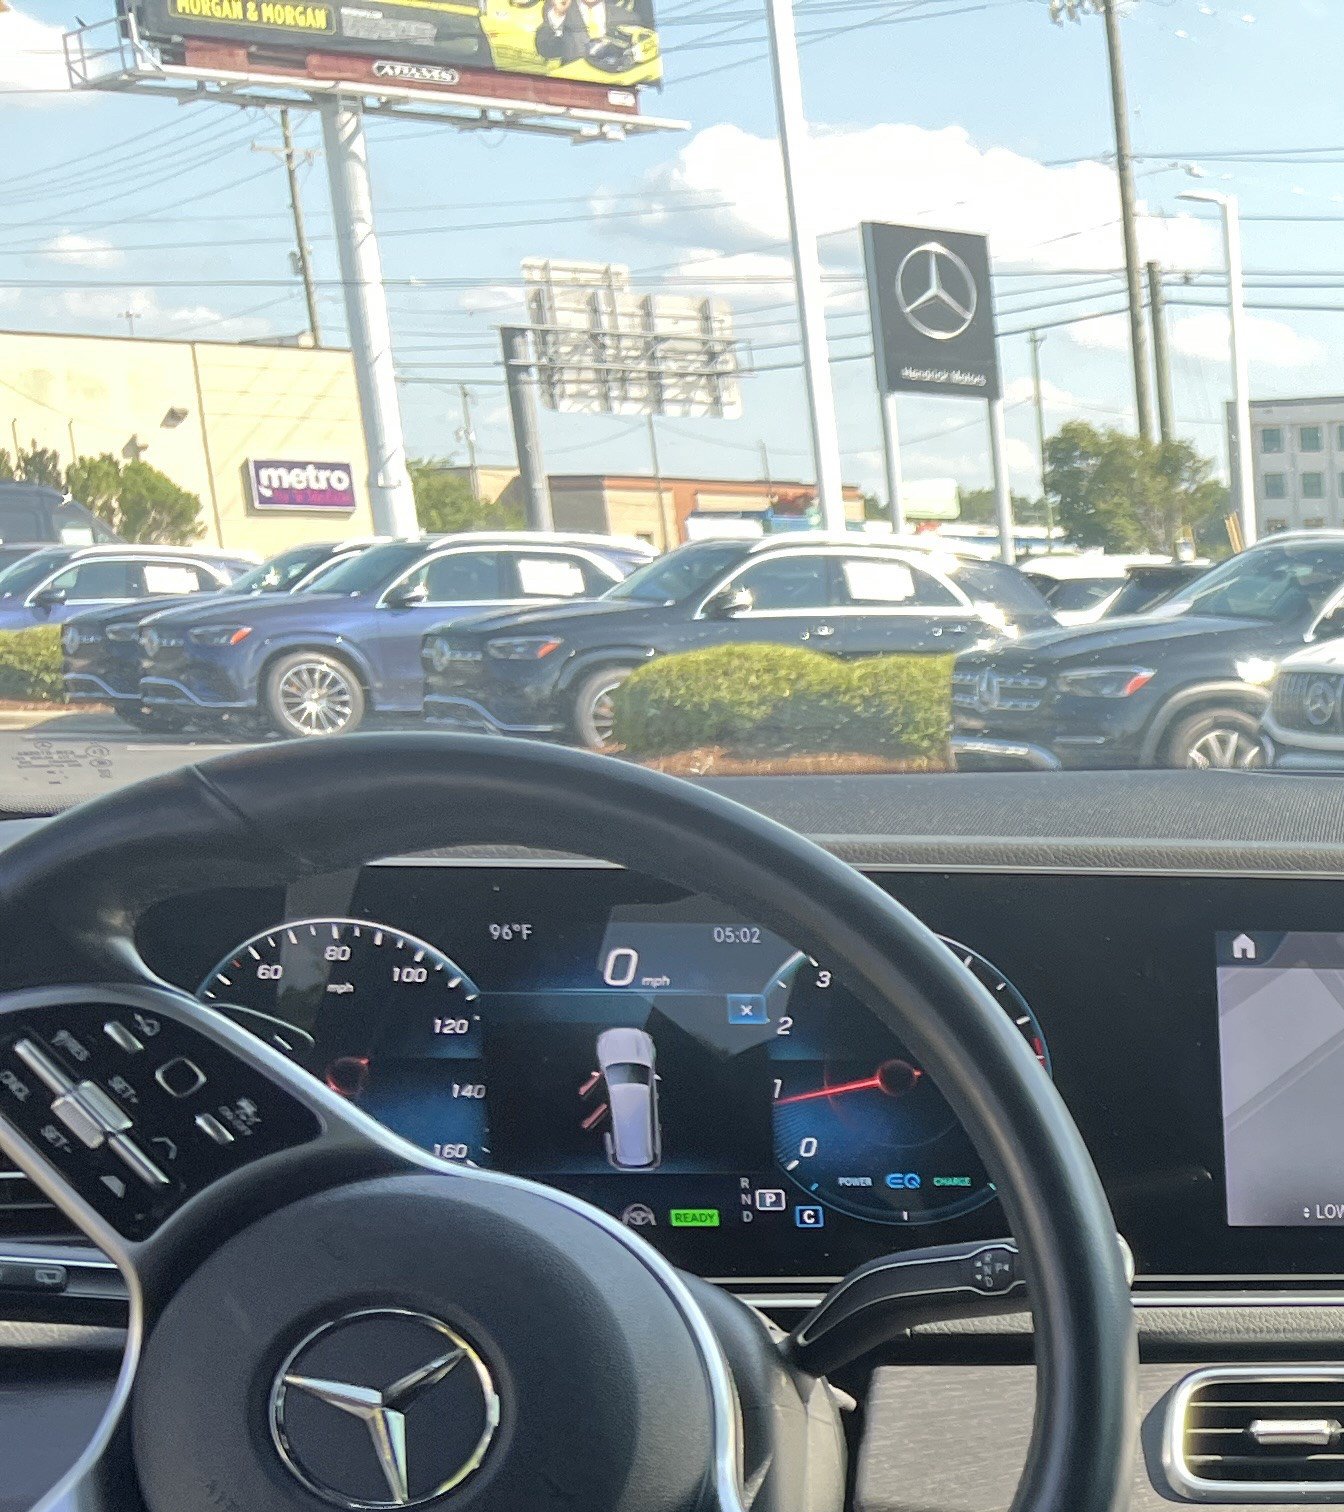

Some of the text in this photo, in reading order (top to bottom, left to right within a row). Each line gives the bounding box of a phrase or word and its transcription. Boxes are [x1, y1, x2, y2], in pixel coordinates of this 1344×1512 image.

[177, 0, 244, 20] MORGAN
[261, 6, 328, 29] MORGAN
[258, 463, 351, 497] metro
[488, 923, 533, 941] 96°F
[713, 926, 762, 944] 05:02
[324, 945, 351, 962] 80
[256, 964, 283, 980] 60
[392, 966, 428, 983] 100
[603, 947, 671, 989] 0 mph
[815, 970, 832, 988] 3
[326, 982, 354, 995] mph
[433, 1018, 469, 1035] 120
[776, 1016, 794, 1036] 2
[451, 1083, 486, 1099] 140
[772, 1078, 783, 1099] 1
[433, 1143, 468, 1159] 160
[799, 1136, 818, 1158] 0
[739, 1177, 750, 1189] R
[740, 1194, 752, 1206] N
[764, 1192, 777, 1207] P
[673, 1211, 717, 1224] READY
[742, 1210, 754, 1223] D
[802, 1210, 816, 1224] C
